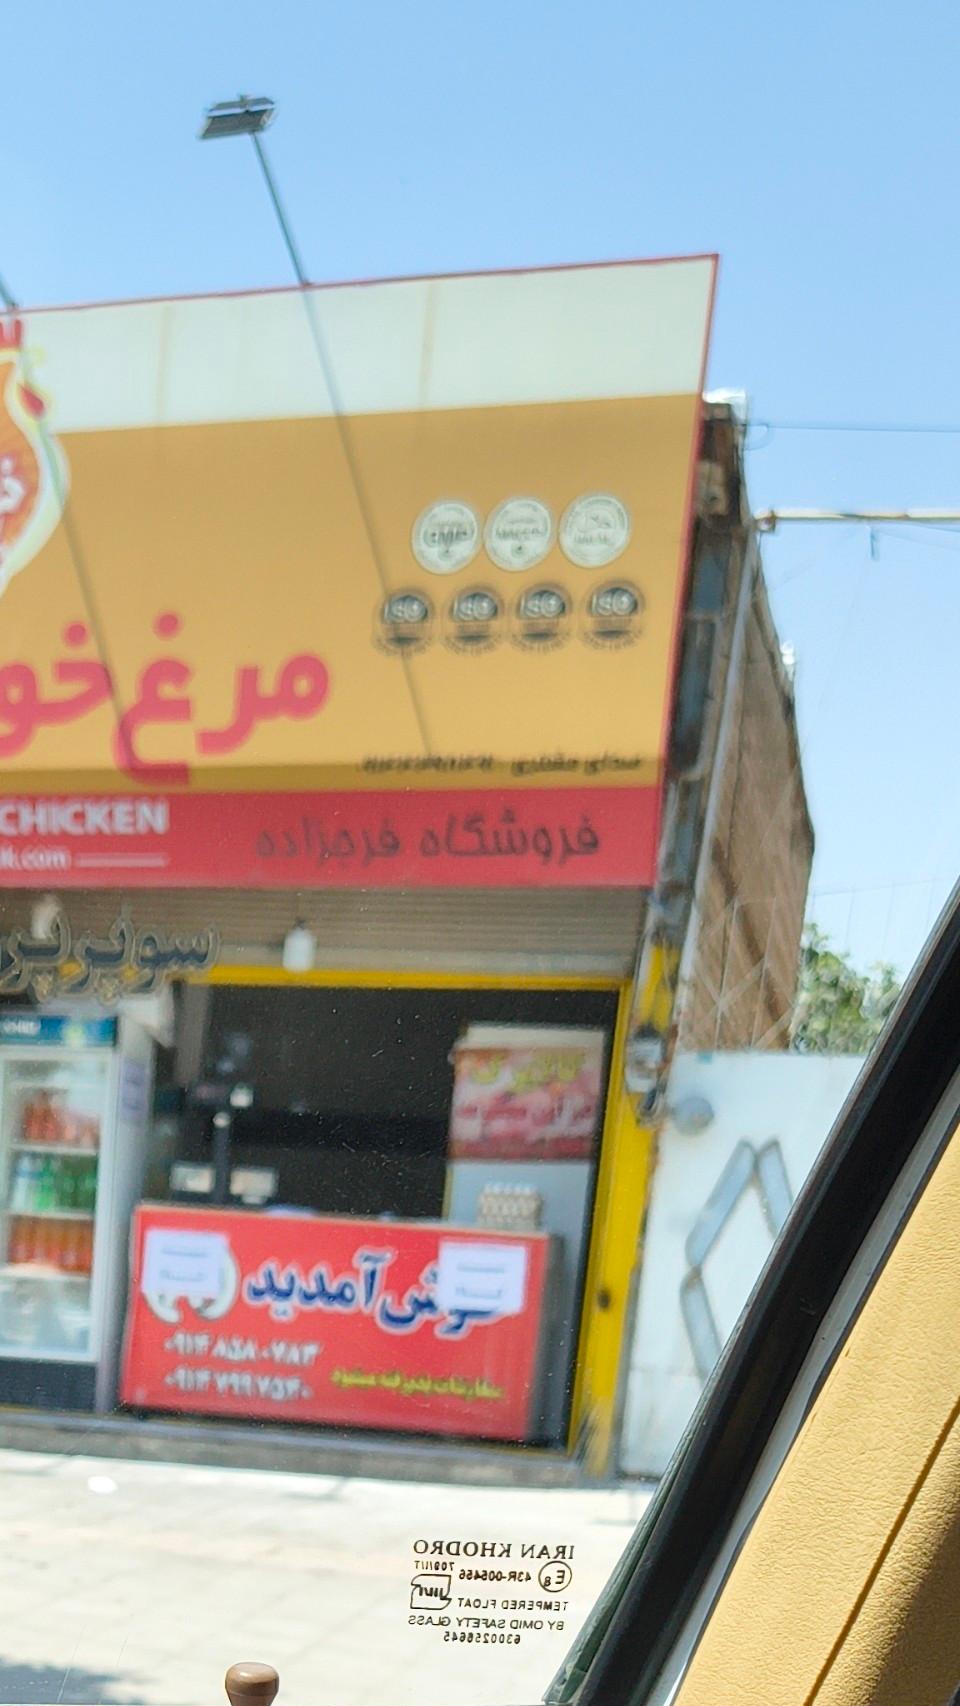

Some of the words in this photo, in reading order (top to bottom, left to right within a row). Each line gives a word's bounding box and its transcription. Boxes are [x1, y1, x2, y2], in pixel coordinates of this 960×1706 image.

[115, 612, 331, 787] مرغ
[419, 807, 600, 866] فروشگاه
[74, 912, 221, 1006] سوپر
[248, 1250, 388, 1318] آمدید
